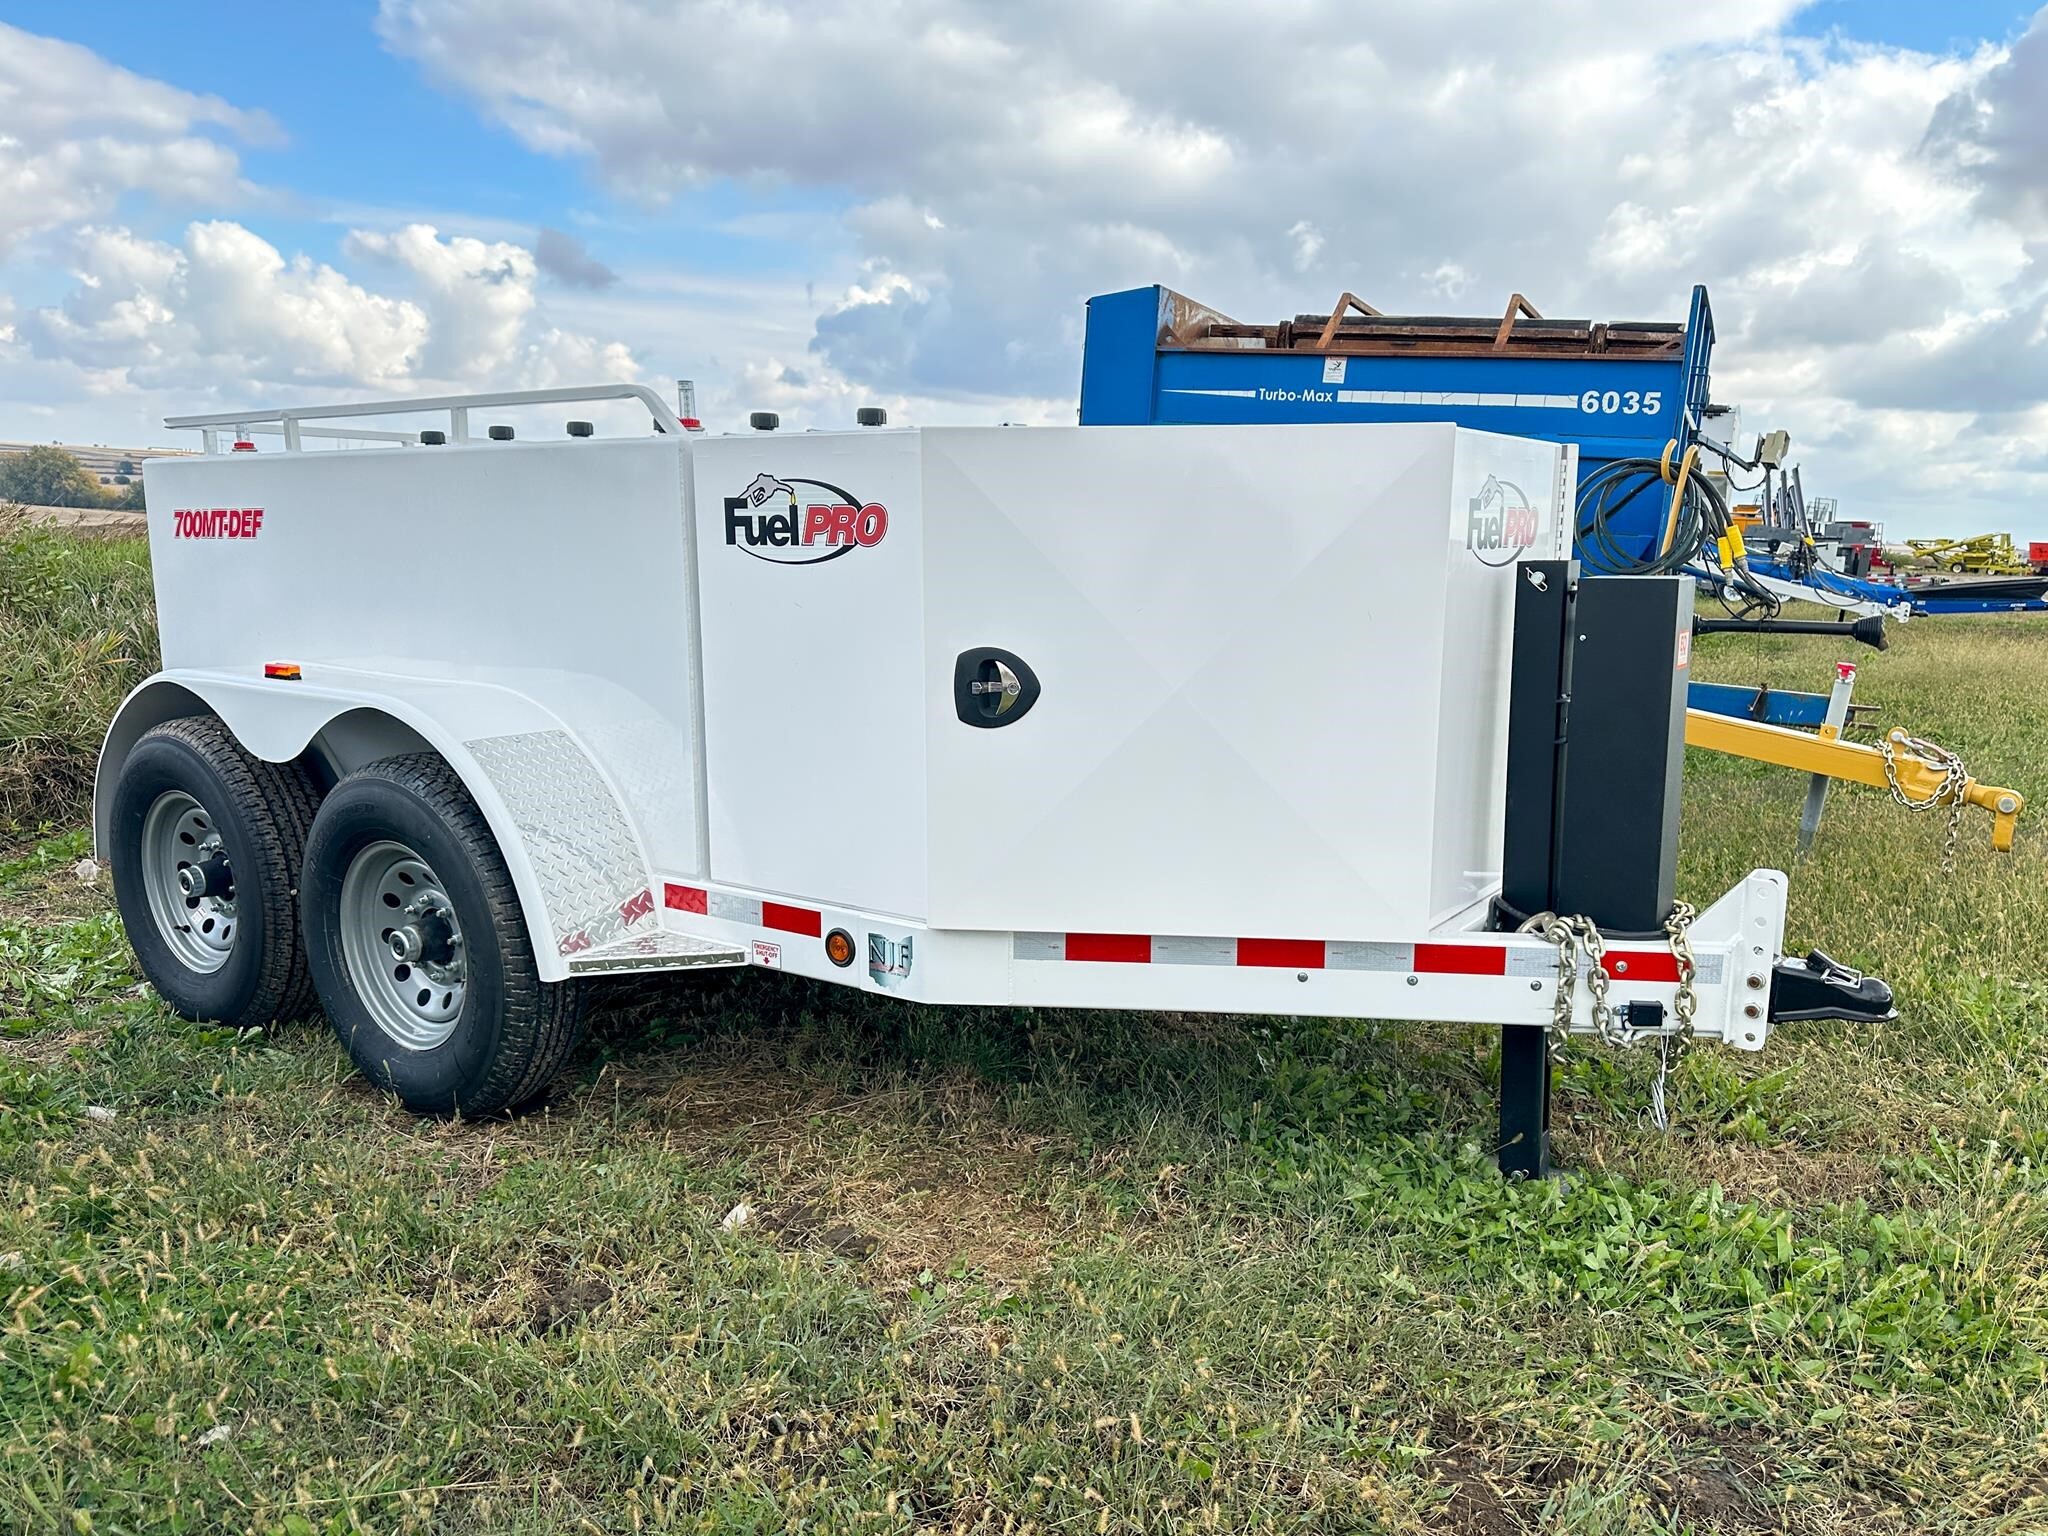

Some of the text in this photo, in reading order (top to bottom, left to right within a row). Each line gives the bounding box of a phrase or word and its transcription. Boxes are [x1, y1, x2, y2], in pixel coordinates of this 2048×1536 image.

[1259, 388, 1333, 402] Turbo-Max
[1582, 390, 1661, 415] 6035
[173, 508, 264, 539] 700MT-DEF
[724, 497, 889, 547] Fuel PRO
[1466, 498, 1539, 550] Fuel PRO
[754, 943, 779, 952] EMERGENCY
[869, 939, 908, 972] NJF
